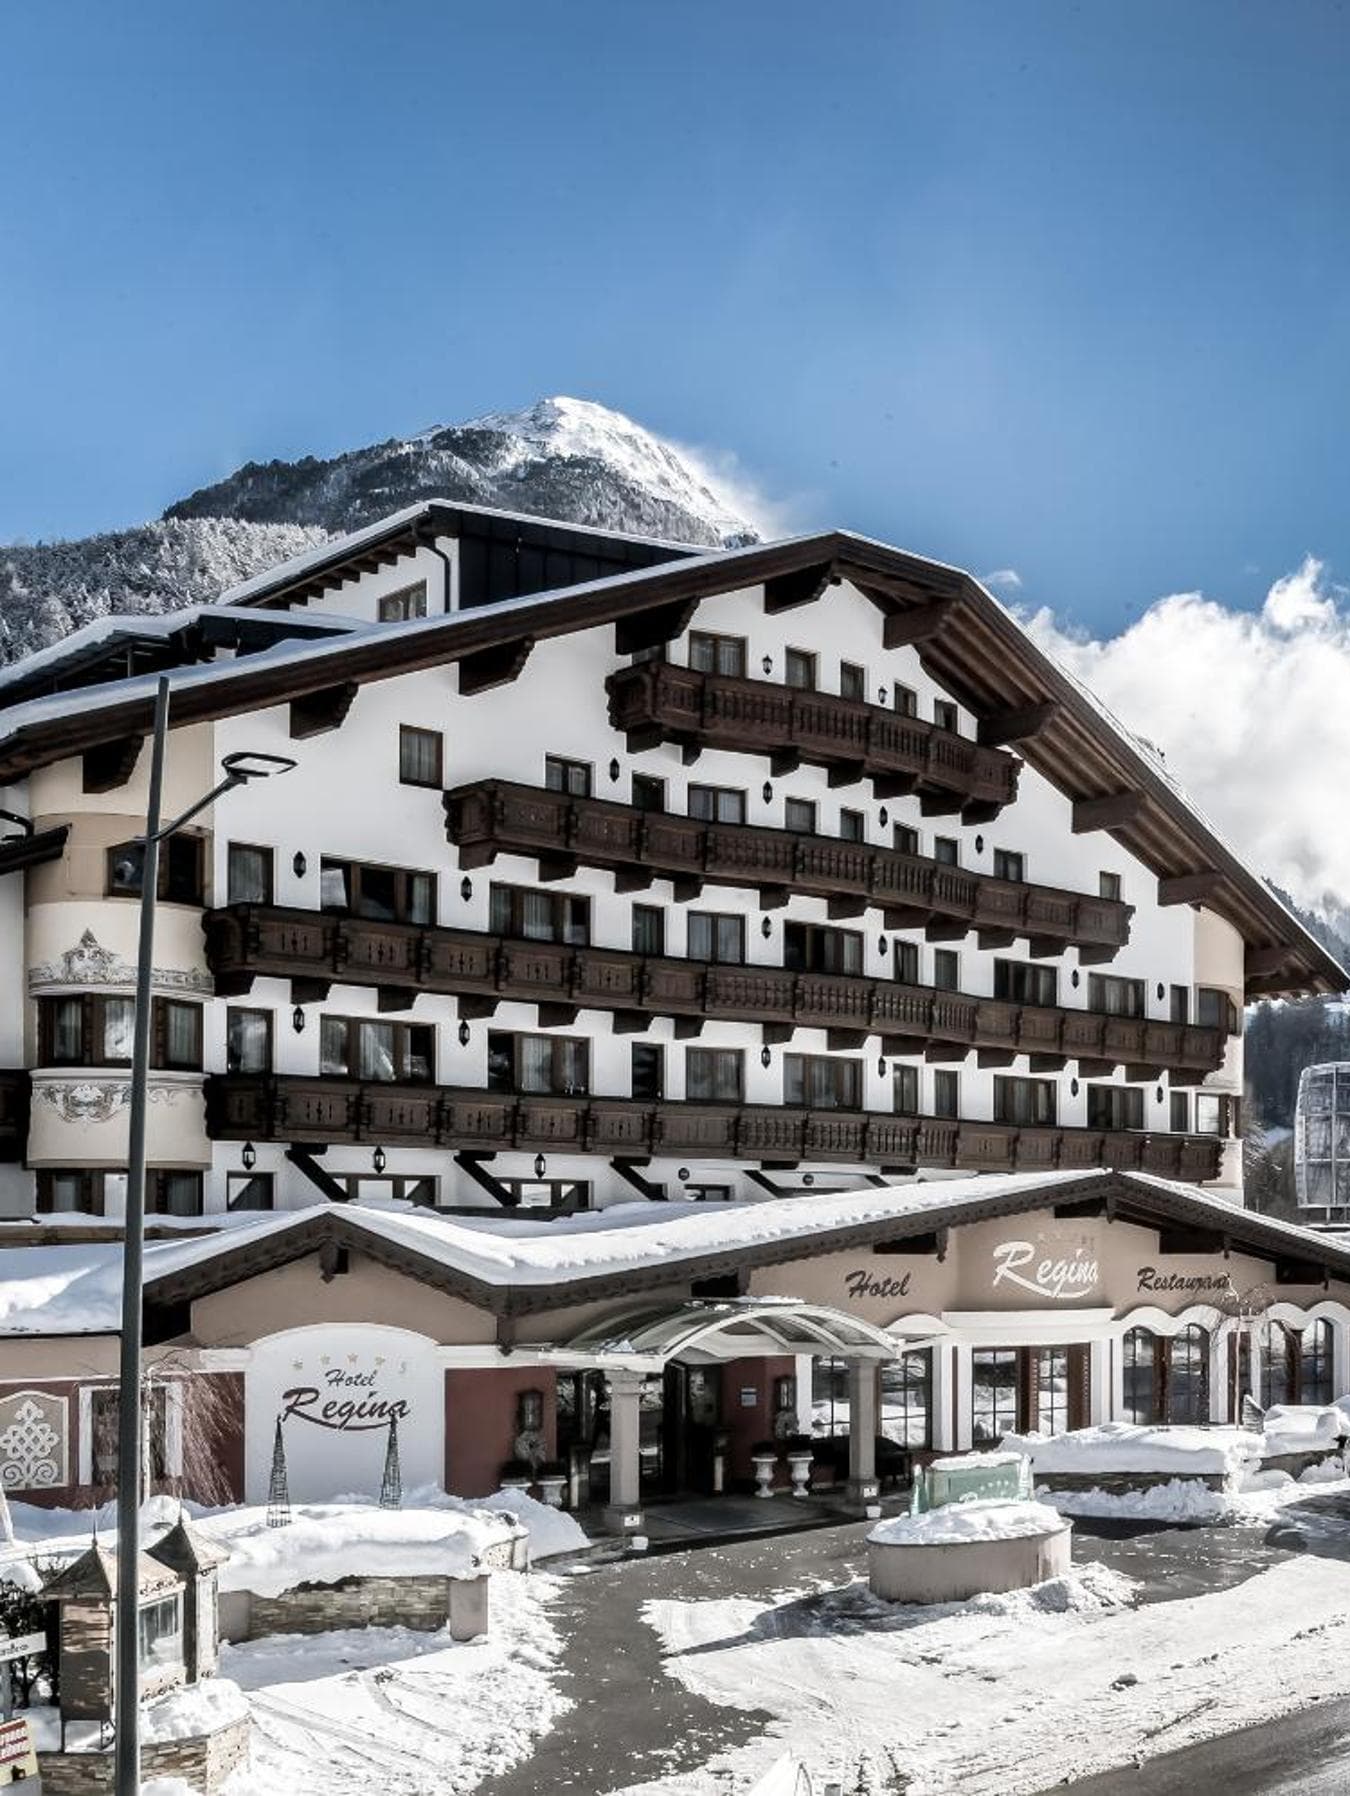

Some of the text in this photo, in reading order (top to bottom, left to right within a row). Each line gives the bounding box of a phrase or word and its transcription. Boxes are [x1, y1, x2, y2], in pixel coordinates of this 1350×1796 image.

[845, 1241, 1232, 1299] Hotel Regina Restaurant
[324, 1368, 378, 1387] Hotel
[282, 1387, 410, 1430] Regina
